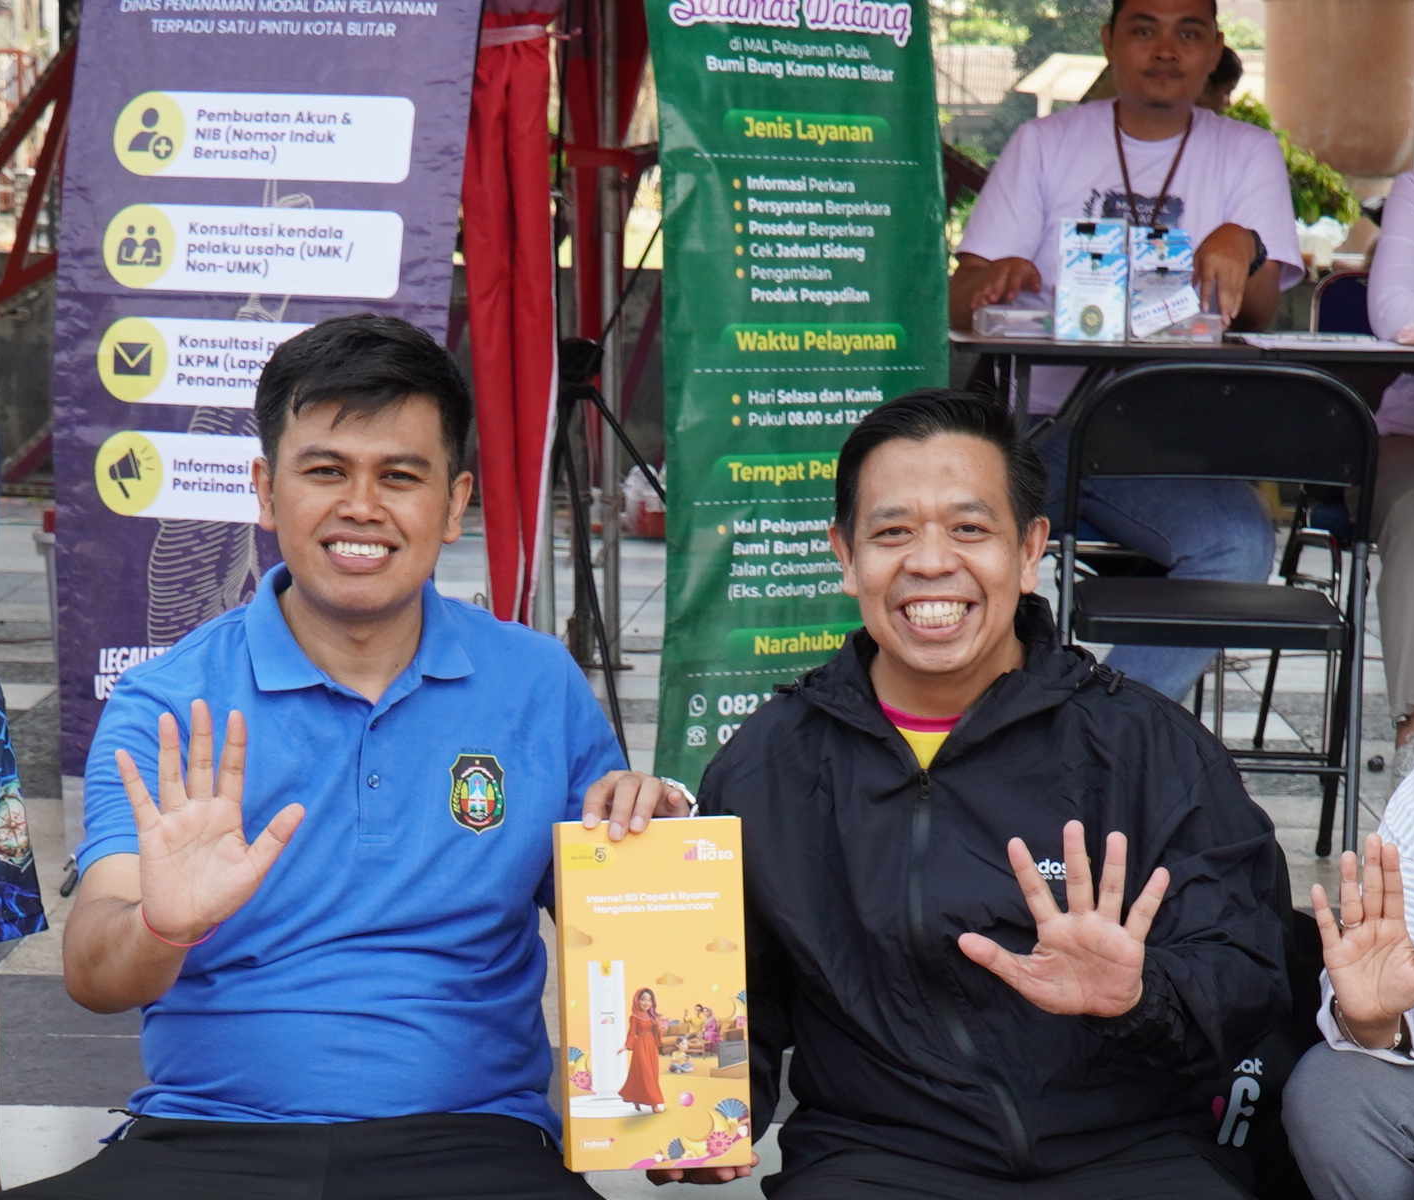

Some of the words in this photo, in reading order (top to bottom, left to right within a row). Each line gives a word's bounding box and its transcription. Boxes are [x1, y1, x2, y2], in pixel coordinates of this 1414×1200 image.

[120, 0, 160, 13] DINAS
[164, 0, 255, 14] PENANAMAN
[258, 0, 310, 15] MODAL
[313, 0, 346, 15] DAN
[349, 1, 437, 16] PELAYANAN
[151, 19, 214, 34] TERPADU
[217, 20, 254, 35] SATU
[258, 20, 302, 36] PINTU
[304, 21, 343, 36] KOTA
[346, 22, 397, 37] BLITAR
[729, 37, 741, 51] di
[743, 38, 771, 54] MAL
[772, 40, 834, 59] Pelayanan
[835, 44, 871, 60] Publik
[706, 55, 745, 72] Bumi
[747, 57, 784, 78] Bung
[786, 60, 825, 78] Karno
[827, 63, 859, 80] Kota
[861, 67, 895, 82] Blitar
[197, 109, 291, 124] Pembuatan
[294, 111, 336, 125] Akun
[341, 112, 352, 125] &
[195, 127, 221, 141] NIB
[225, 127, 286, 145] (Nomor
[289, 129, 336, 144] Induk
[743, 117, 792, 139] Jenis
[796, 119, 873, 145] Layanan
[193, 145, 277, 164] Berusaha)
[747, 175, 806, 193] Informasi
[809, 179, 855, 194] Perkara
[748, 198, 823, 217] Persyaratan
[825, 200, 891, 218] Berperkara
[189, 222, 274, 239] Konsultasi
[277, 223, 343, 240] kendala
[749, 220, 806, 237] Prosedur
[808, 222, 874, 240] Berperkara
[187, 240, 242, 258] pelaku
[245, 242, 296, 258] usaha
[300, 241, 342, 261] (UMK
[750, 243, 773, 258] Cek
[775, 244, 821, 259] Jadwal
[822, 245, 866, 262] Sidang
[186, 259, 269, 279] Non-UMK)
[750, 265, 832, 283] Pengambilan
[751, 287, 797, 303] Produk
[800, 289, 870, 305] Pengadilan
[179, 335, 263, 351] Konsultasi
[735, 330, 800, 352] Waktu
[804, 331, 897, 355] Pelayanan
[178, 354, 218, 368] LKPM
[748, 389, 776, 404] Hari
[777, 389, 817, 404] Selasa
[819, 388, 843, 403] dan
[845, 386, 883, 403] Kamis
[748, 410, 786, 426] Pukul
[787, 411, 823, 426] 08.00
[825, 409, 843, 424] s.d
[173, 459, 249, 474] Informasi
[728, 461, 805, 486] Tempat
[172, 479, 245, 493] Perizinan
[733, 518, 757, 534] Mal
[760, 518, 828, 536] Pelayanan
[732, 539, 770, 555] Bumi
[773, 540, 808, 556] Bung
[729, 562, 767, 577] Jalan
[728, 583, 762, 601] (Eks.
[765, 582, 816, 598] Gedung
[586, 894, 623, 903] Internet
[625, 894, 638, 902] 5G
[640, 892, 668, 903] Cepat
[678, 891, 720, 901] Nyaman
[593, 905, 645, 915] Hangatkan
[647, 902, 713, 912] Kebersamaan
